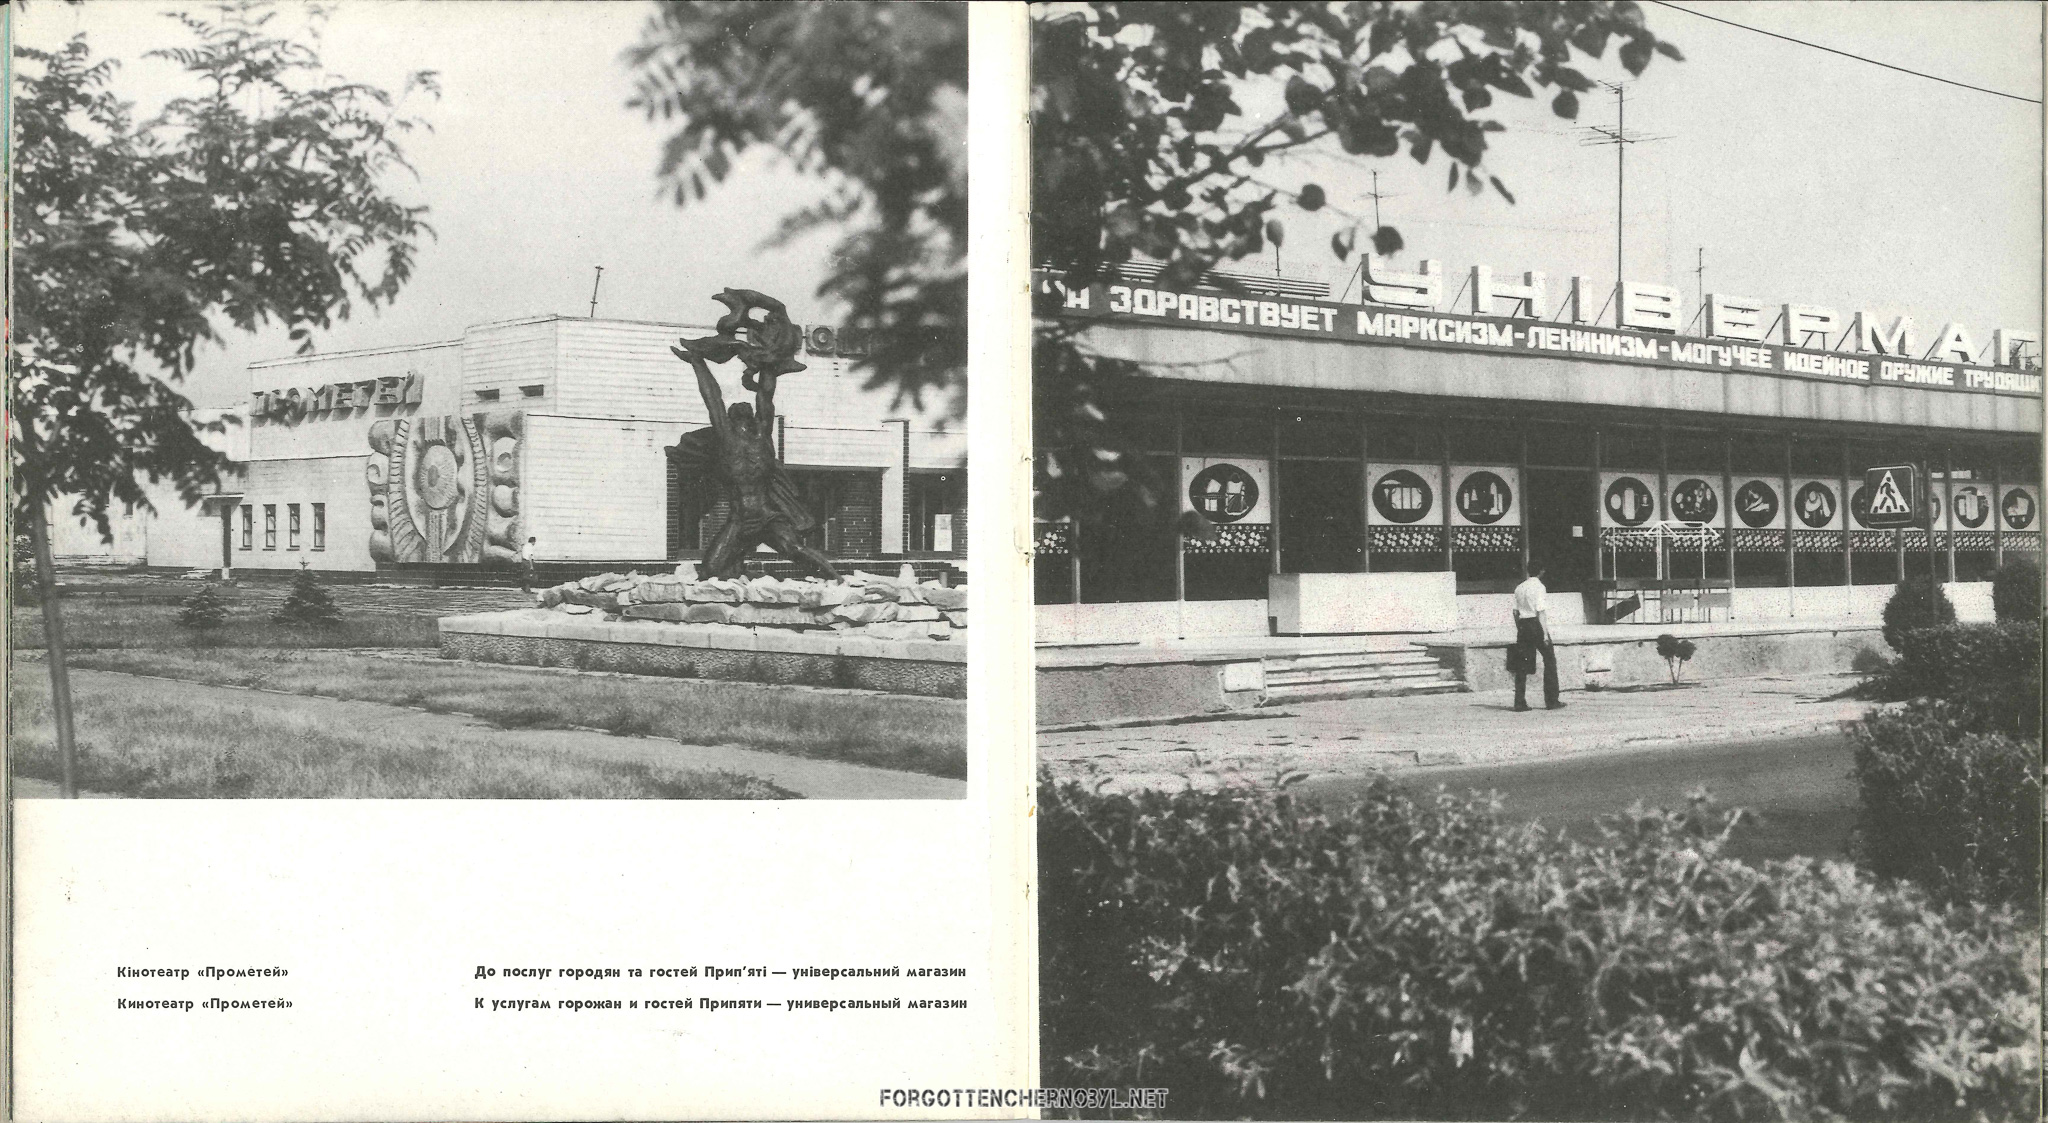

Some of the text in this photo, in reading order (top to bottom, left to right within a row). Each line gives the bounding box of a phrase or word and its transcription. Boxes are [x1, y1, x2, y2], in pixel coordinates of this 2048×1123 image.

[1361, 252, 2042, 368] УНІВЕРМАГ
[1109, 285, 1338, 332] ЗДРАВСТВУЕТ
[1783, 350, 1870, 381] ИДЕЙНОЕ
[1880, 360, 1954, 386] ОРУЖИЕ
[117, 966, 289, 981] Кінотеатр «Прометей»
[474, 965, 496, 980] До
[503, 967, 552, 980] послуг
[558, 968, 621, 981] городян
[627, 968, 643, 978] та
[649, 965, 698, 978] гостей
[792, 965, 900, 981] універсальний
[906, 967, 966, 978] магазин
[117, 997, 293, 1013] Кинотеатр «Прометей»
[474, 997, 484, 1009] К
[491, 999, 551, 1012] услугам
[558, 999, 622, 1013] горожан
[629, 1000, 638, 1009] и
[644, 997, 693, 1009] гостей
[699, 997, 762, 1012] Припяти
[786, 997, 901, 1012] универсальный
[907, 999, 968, 1009] магазин
